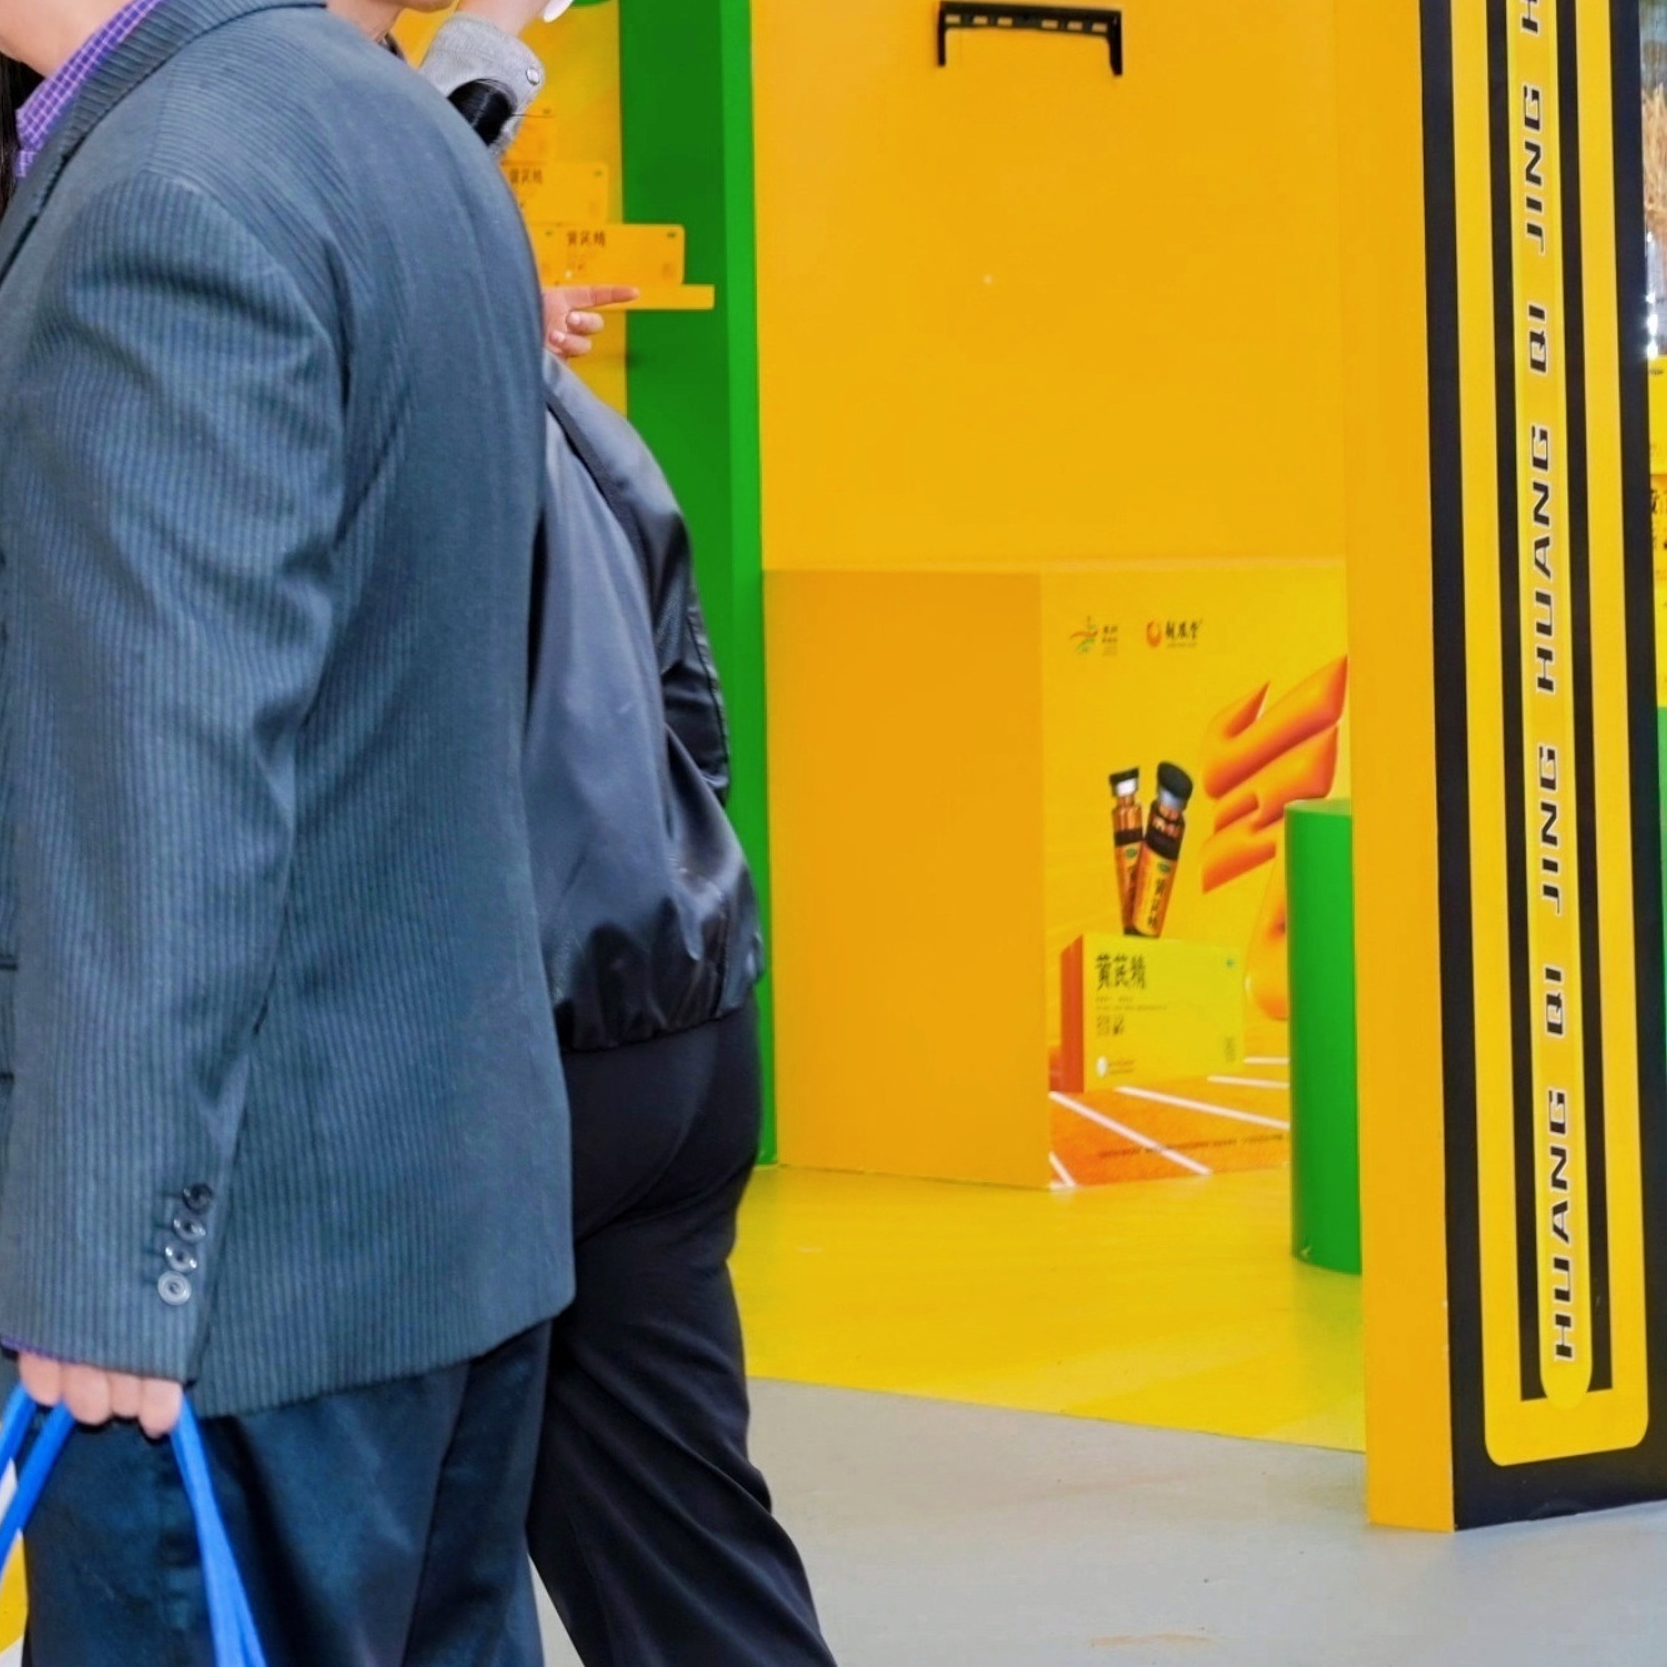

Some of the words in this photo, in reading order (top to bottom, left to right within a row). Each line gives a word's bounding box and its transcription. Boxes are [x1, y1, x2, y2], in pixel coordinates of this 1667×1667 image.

[1522, 85, 1546, 255] JING
[1527, 301, 1548, 376] QI
[1530, 424, 1556, 694] HUANG
[1538, 743, 1562, 916] JING
[1543, 965, 1565, 1037] QI
[1547, 1088, 1574, 1363] HUANG
